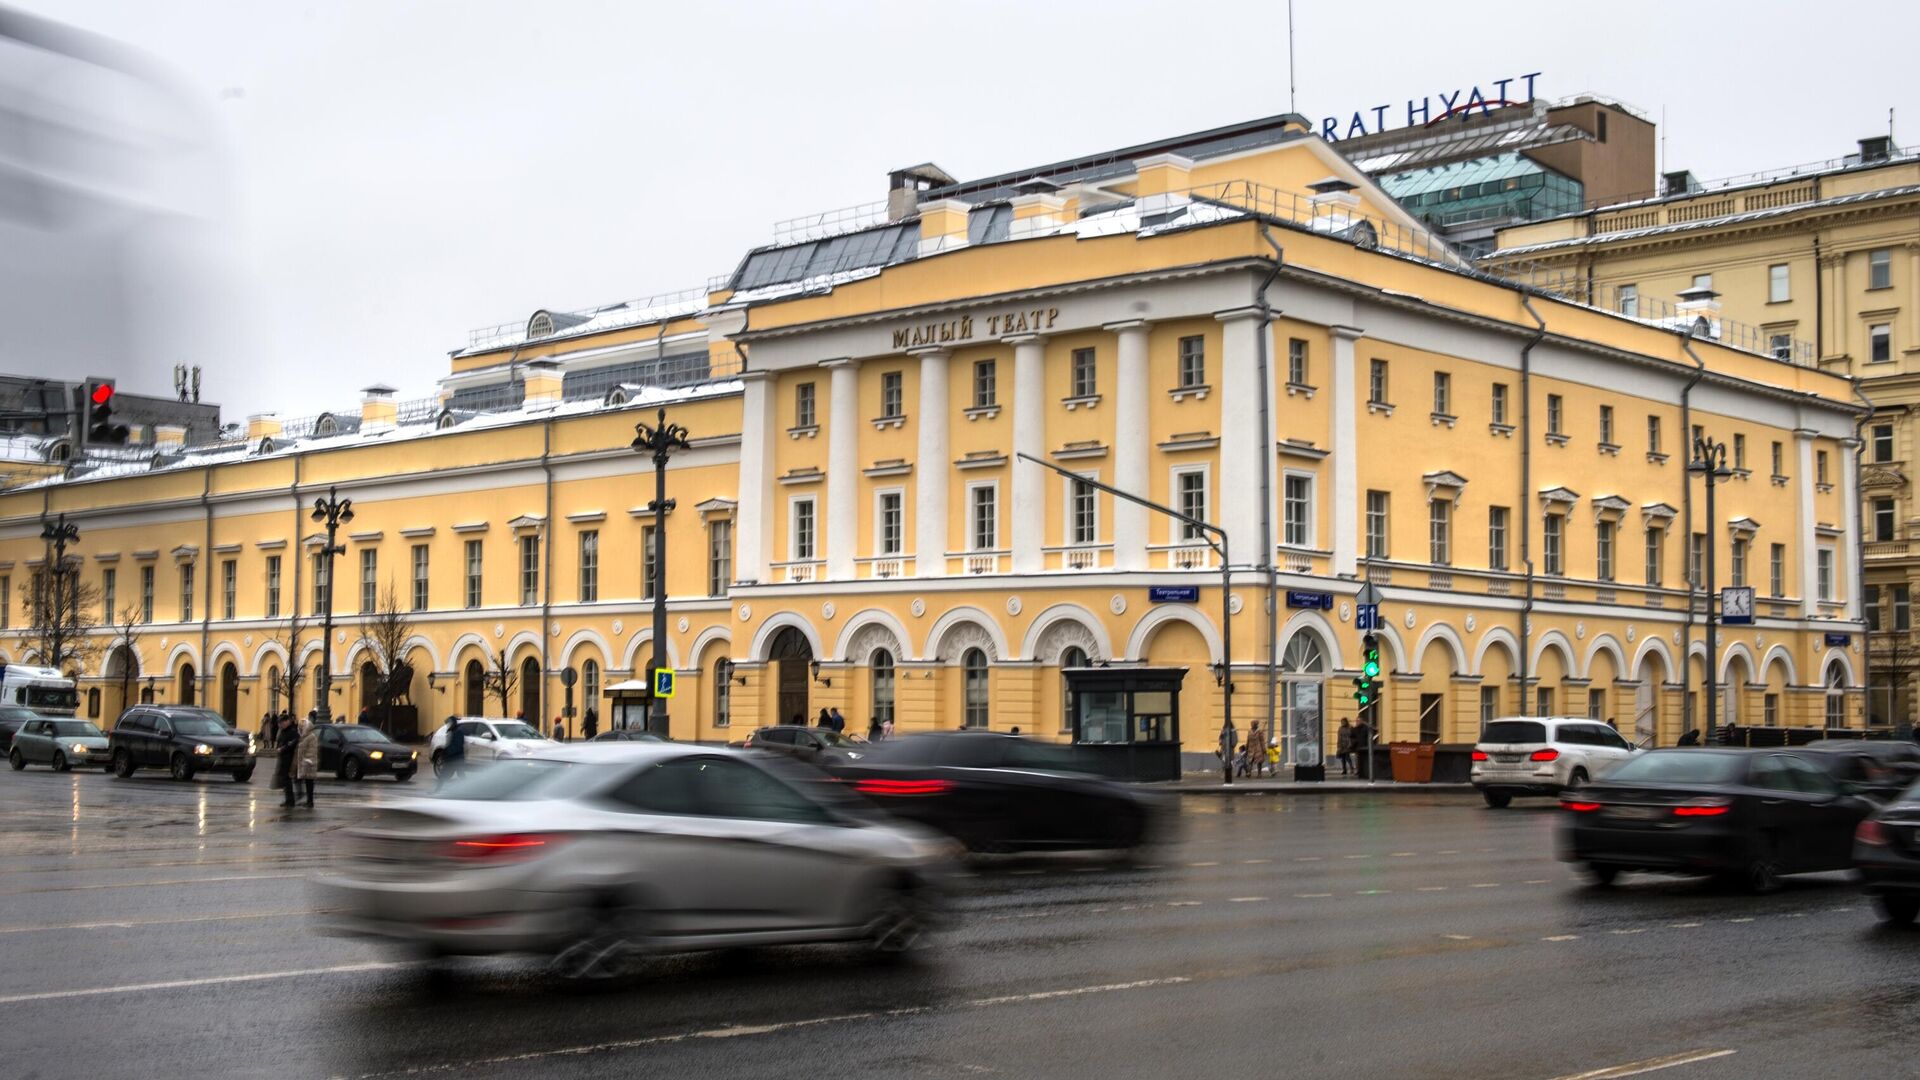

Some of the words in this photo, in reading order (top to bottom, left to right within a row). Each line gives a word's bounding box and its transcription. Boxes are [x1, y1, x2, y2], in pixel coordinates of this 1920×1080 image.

[1407, 72, 1543, 127] HYATT
[892, 315, 974, 349] МАЛЫЙ
[986, 308, 1059, 336] ТЕАТР
